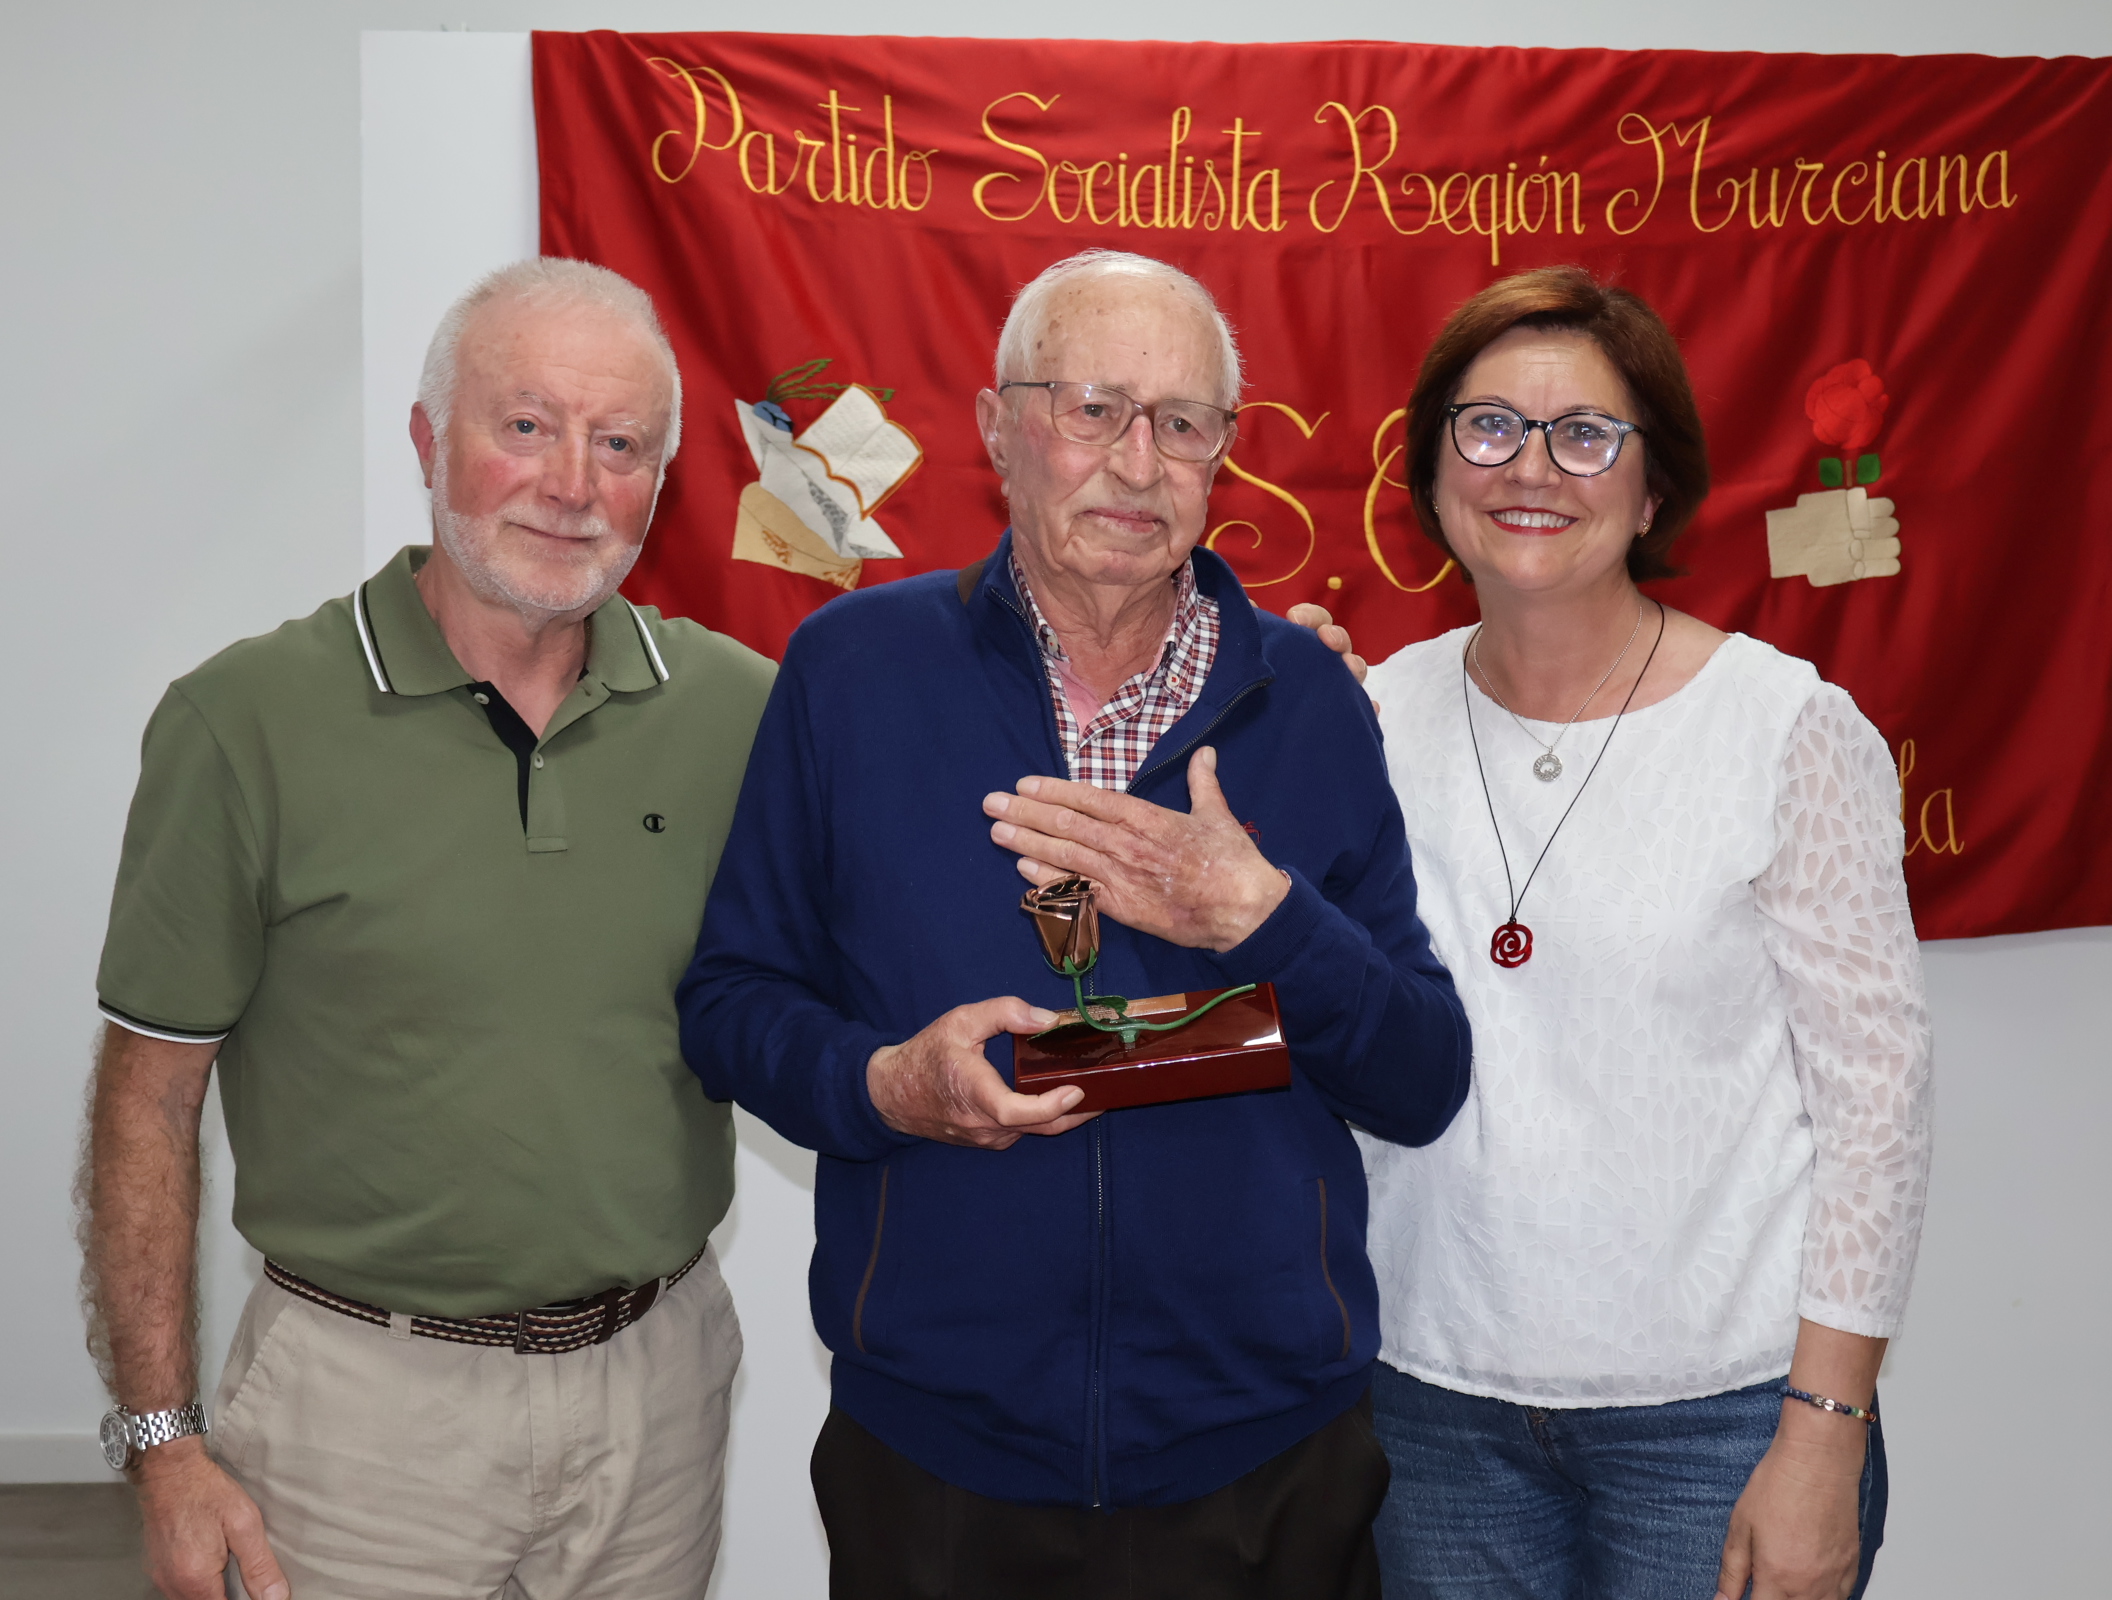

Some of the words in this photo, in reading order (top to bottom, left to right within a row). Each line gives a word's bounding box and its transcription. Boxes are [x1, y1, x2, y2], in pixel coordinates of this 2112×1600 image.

[646, 56, 940, 212] Partido
[972, 91, 1288, 232] Socialista
[1308, 100, 1586, 267] Región
[1605, 112, 2019, 236] Murciana
